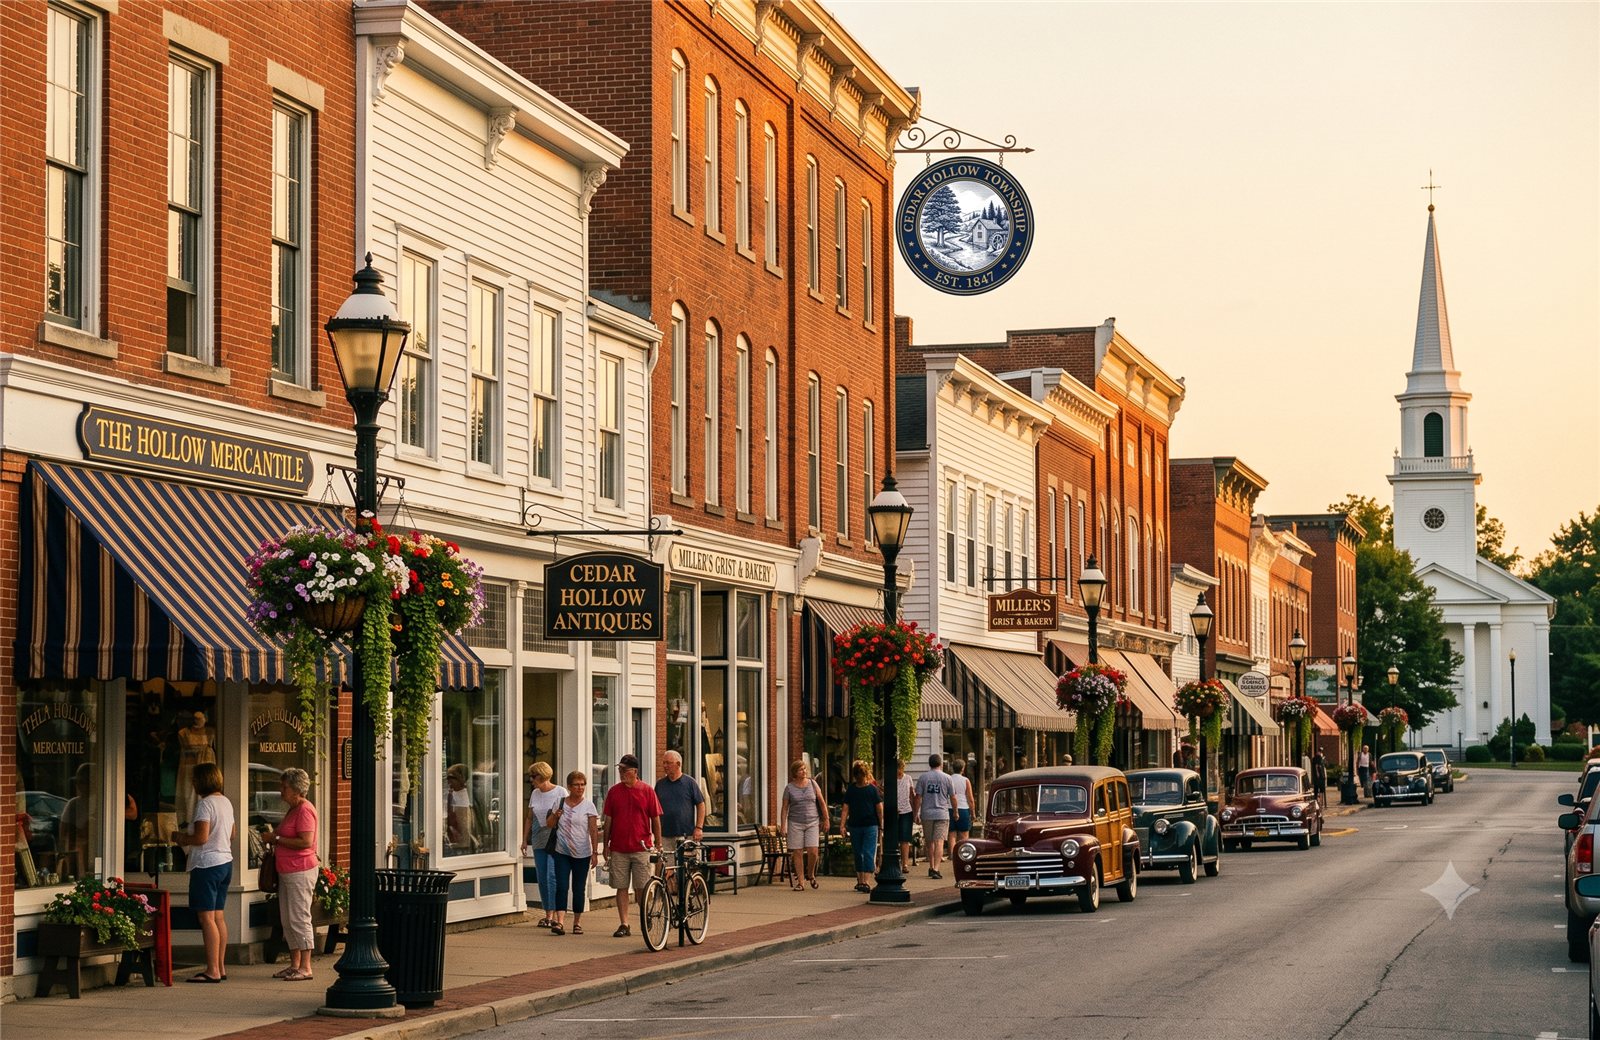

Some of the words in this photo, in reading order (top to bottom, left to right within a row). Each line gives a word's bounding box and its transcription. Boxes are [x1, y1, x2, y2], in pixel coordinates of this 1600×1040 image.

[903, 188, 926, 233] CEDAR
[923, 165, 980, 190] HOLLOW
[984, 169, 1026, 233] TOWNSHIP
[934, 271, 962, 288] EST.
[966, 271, 994, 288] 1847
[96, 418, 132, 453] THE
[136, 425, 207, 466] HOLLOW
[210, 440, 304, 483] MERCANTILE
[569, 564, 637, 583] CEDAR
[679, 549, 714, 573] MILLER'S
[715, 556, 737, 577] GRIST
[738, 560, 744, 578] &
[745, 561, 772, 583] BAKERY
[560, 588, 646, 607] HOLLOW
[995, 598, 1051, 612] MILLER'S
[553, 612, 653, 634] ANTIQUES
[992, 617, 1015, 626] GRIST
[1016, 617, 1022, 626] &
[1024, 617, 1054, 626] BAKERY
[33, 741, 85, 754] MERCANTILE
[259, 741, 297, 753] MERCANTILE
